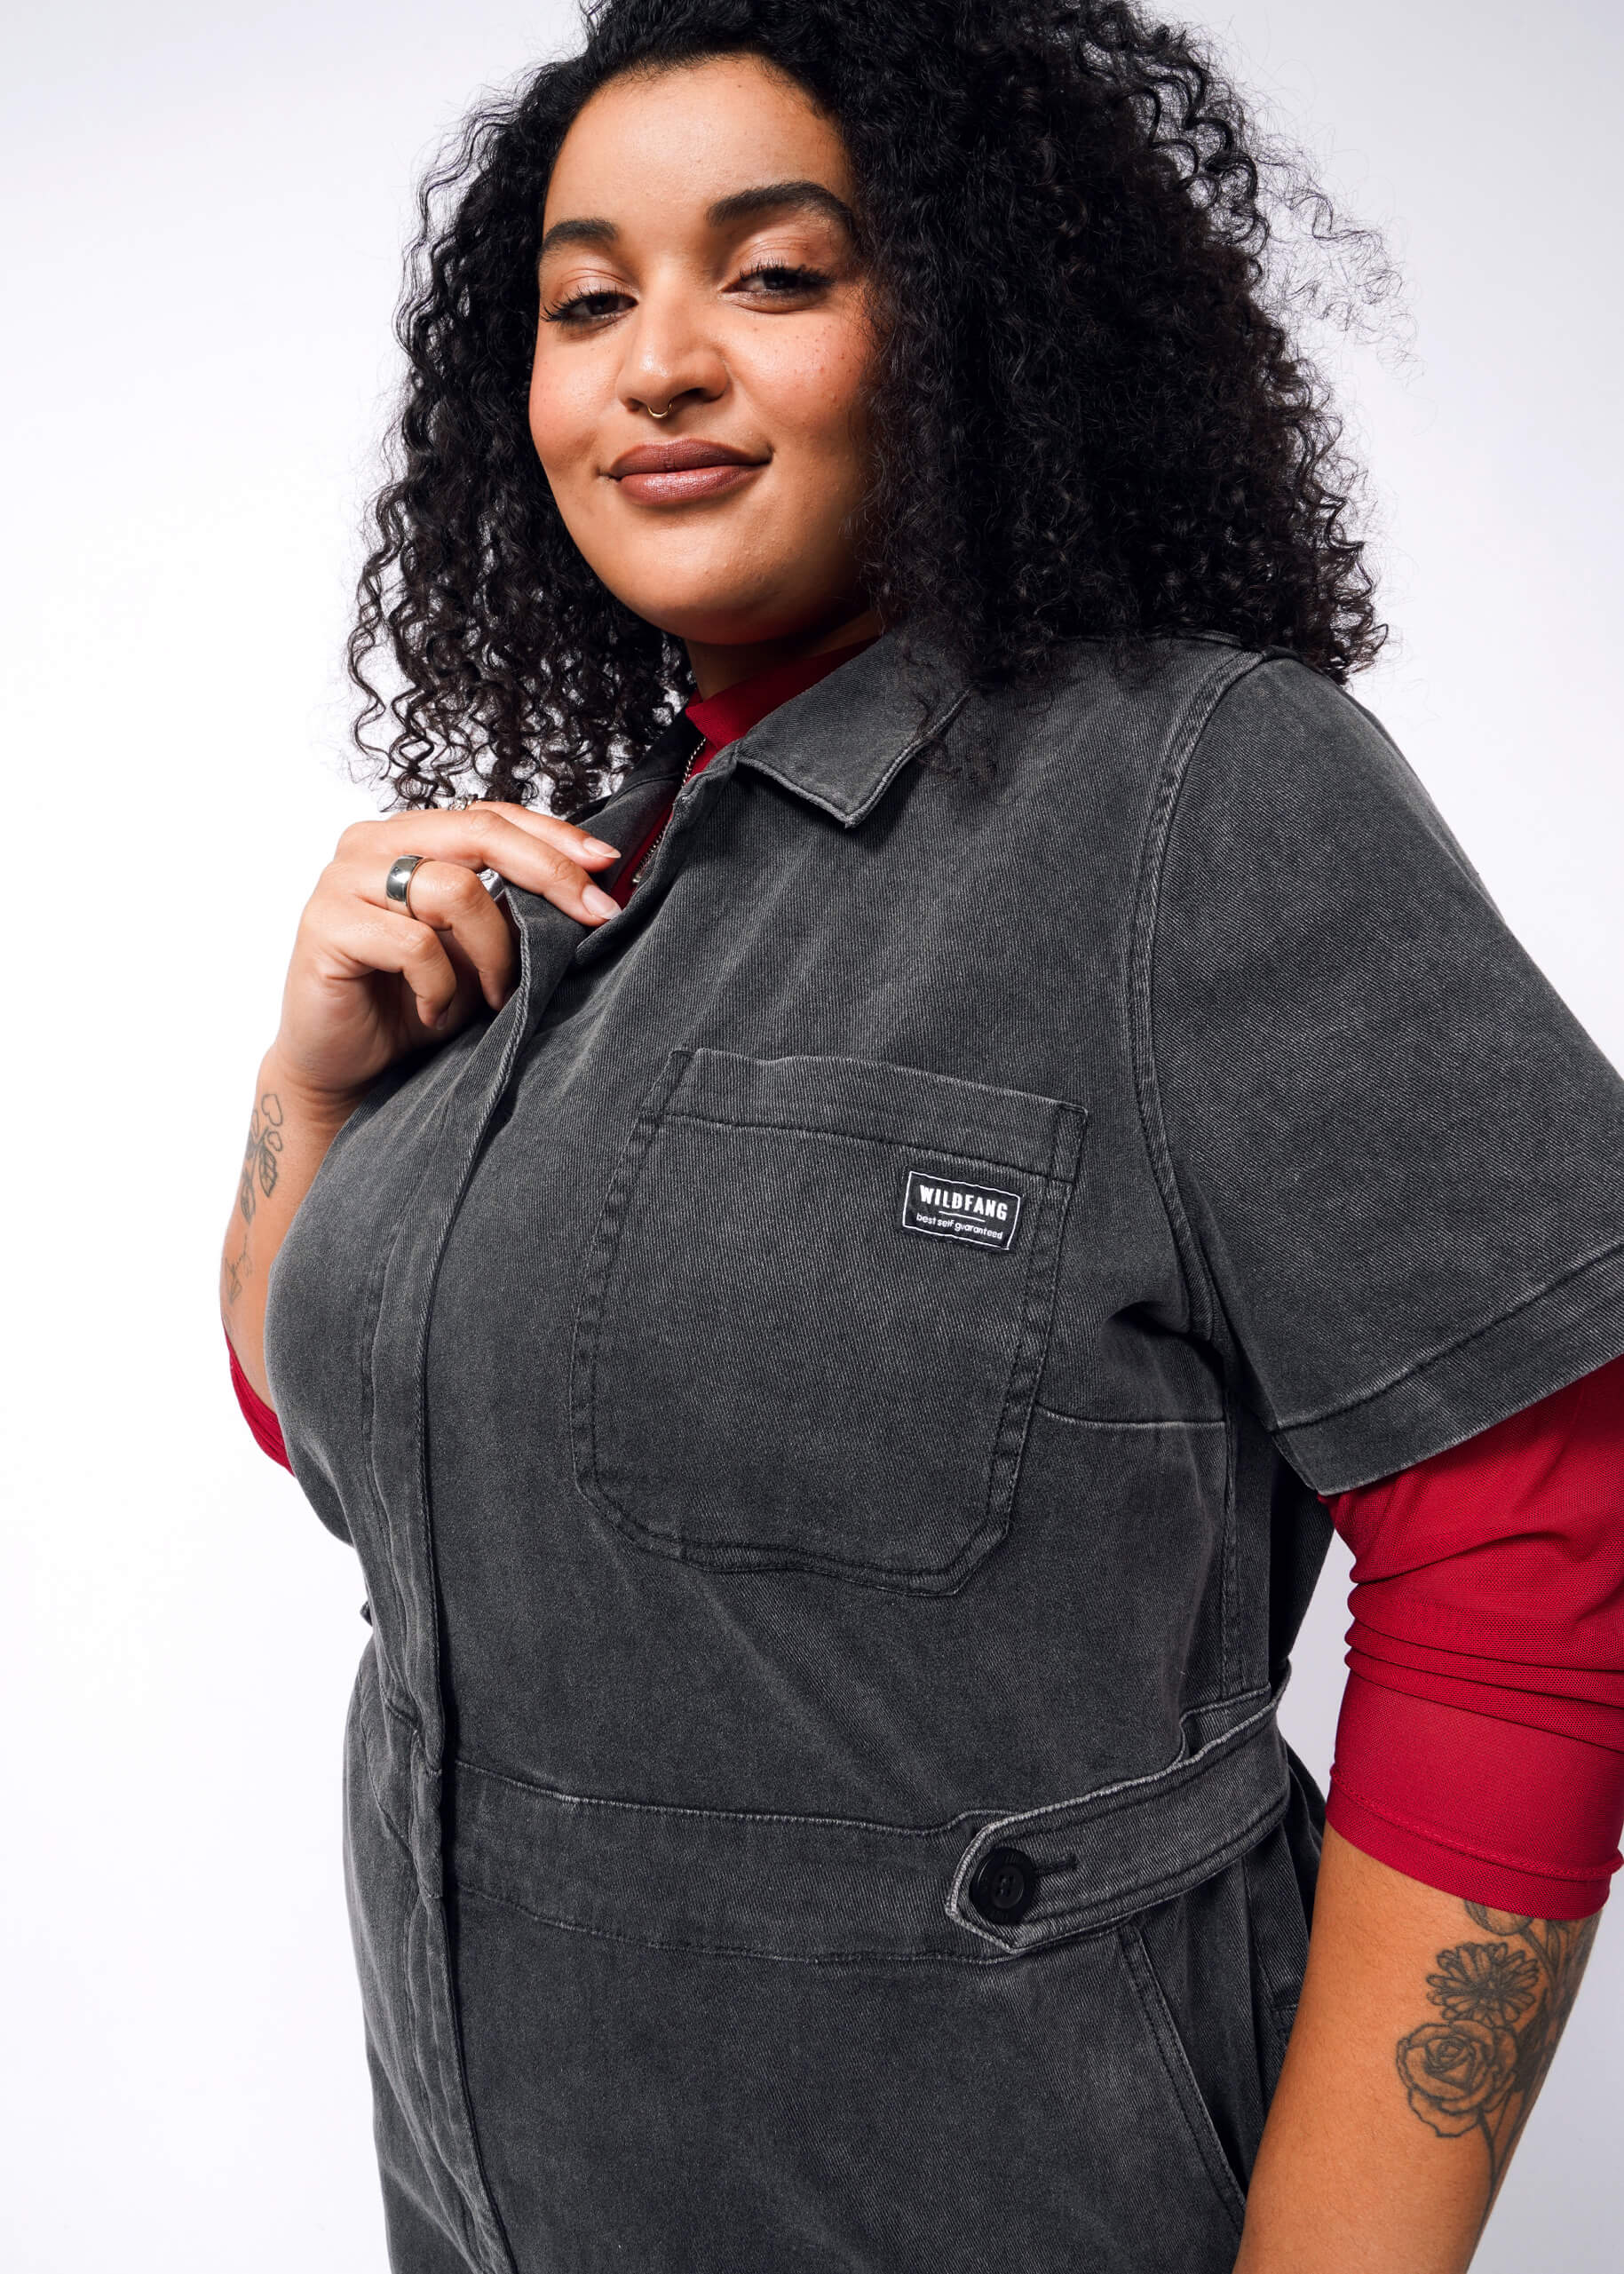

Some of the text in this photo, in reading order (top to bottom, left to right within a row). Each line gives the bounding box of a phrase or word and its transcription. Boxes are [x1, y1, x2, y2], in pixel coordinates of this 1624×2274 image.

[919, 1185, 1009, 1221] WILDFANG
[916, 1213, 1003, 1240] best self guaranteed
